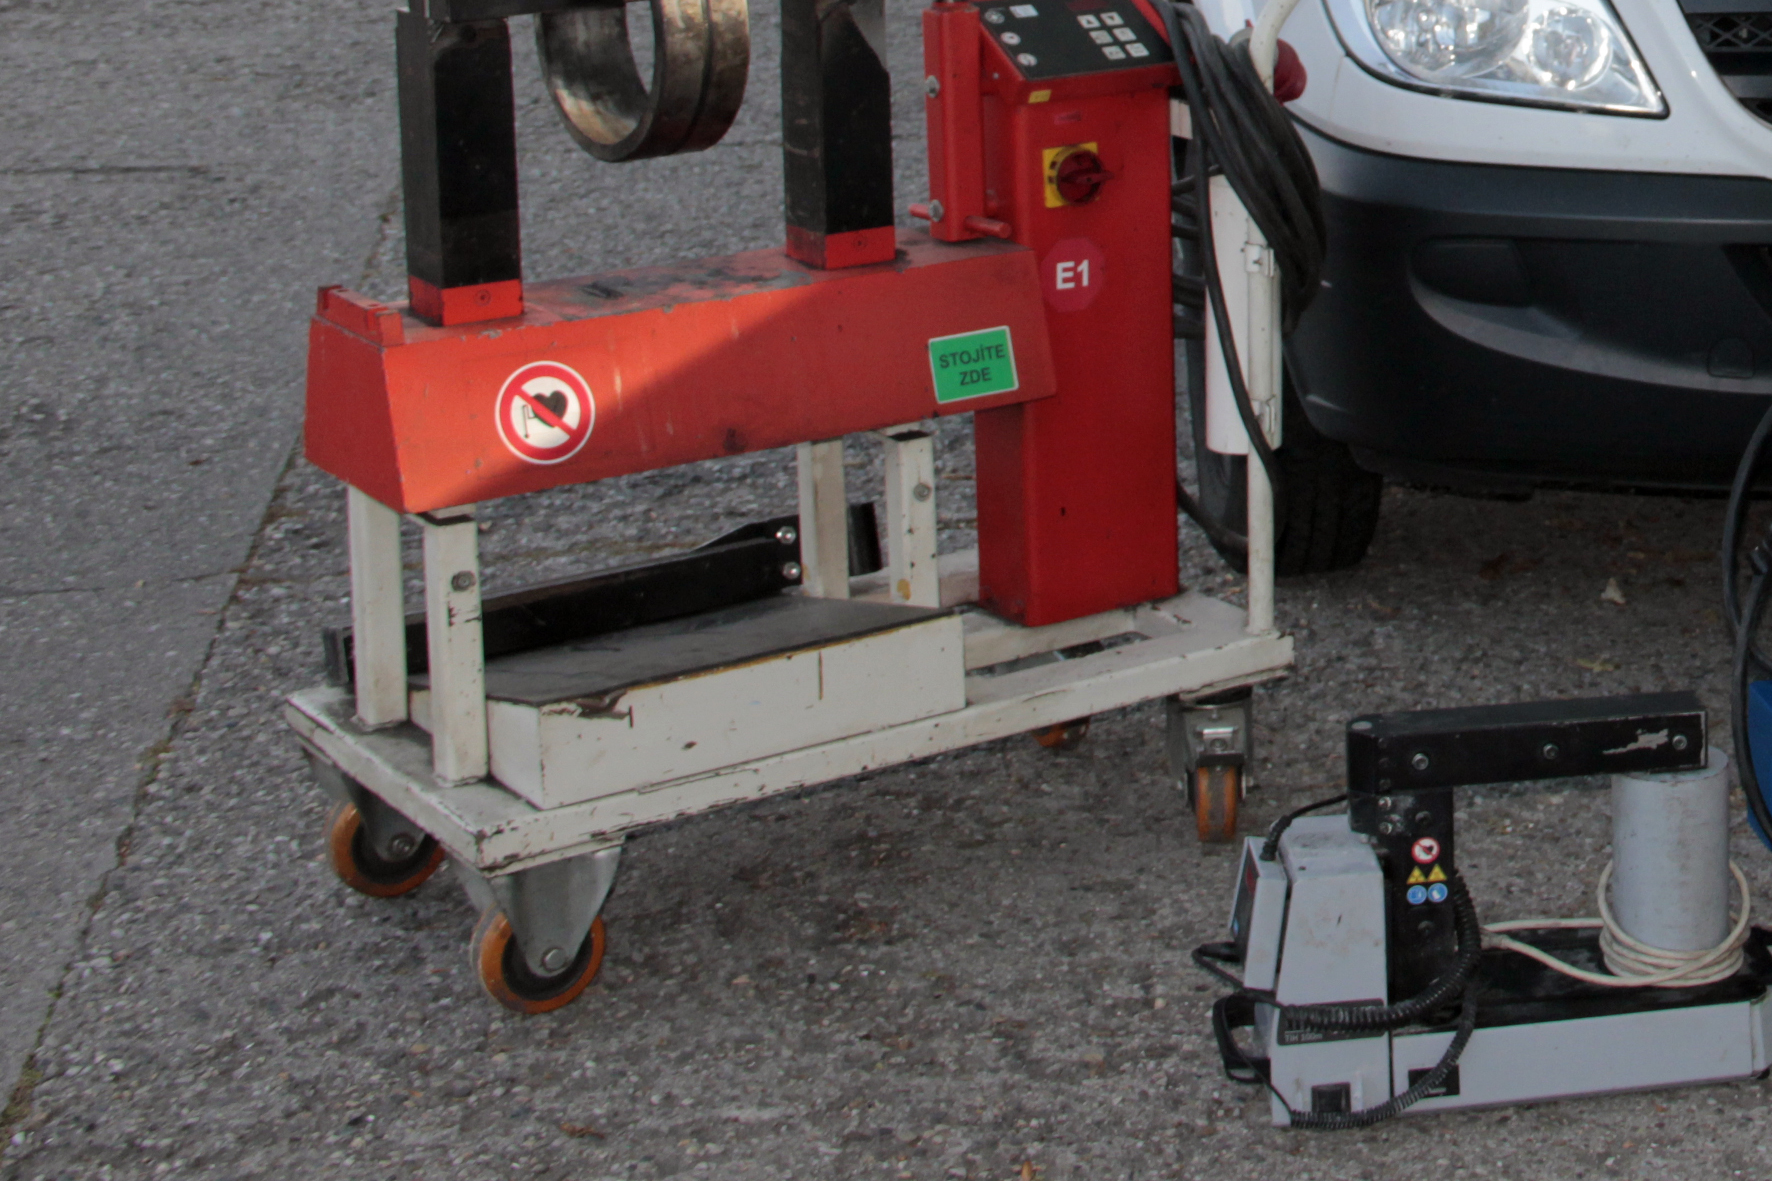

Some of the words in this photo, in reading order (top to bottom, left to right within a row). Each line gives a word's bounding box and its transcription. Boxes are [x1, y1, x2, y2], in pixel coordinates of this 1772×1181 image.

[1055, 259, 1090, 290] E1
[938, 343, 1006, 369] STOJÍTE
[959, 366, 993, 386] ZDE
